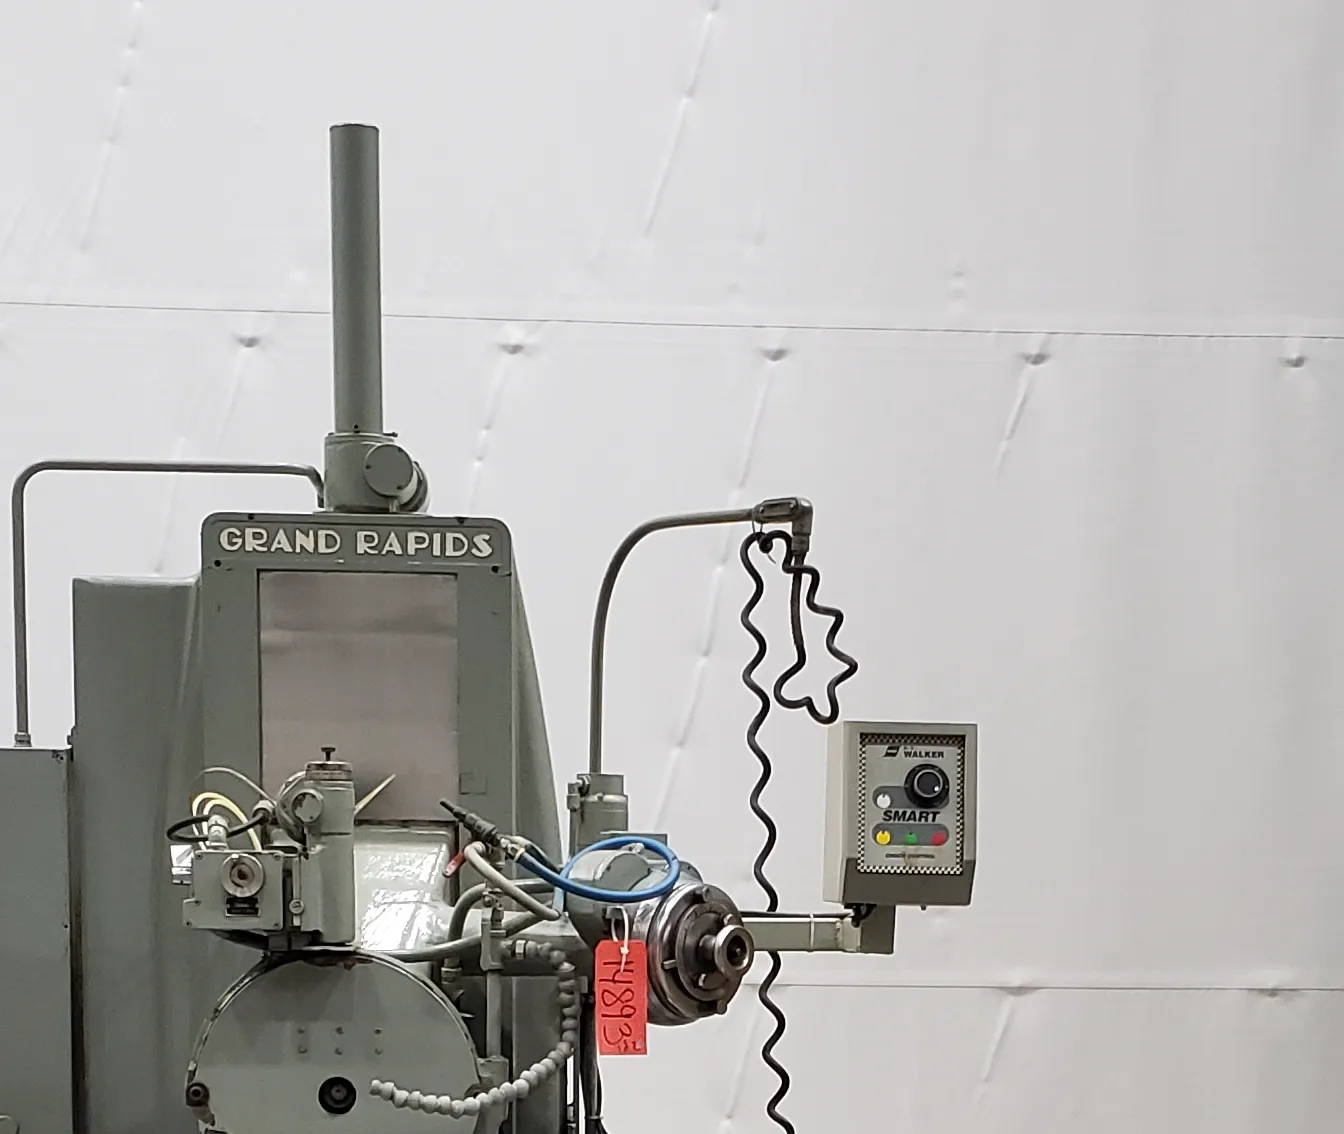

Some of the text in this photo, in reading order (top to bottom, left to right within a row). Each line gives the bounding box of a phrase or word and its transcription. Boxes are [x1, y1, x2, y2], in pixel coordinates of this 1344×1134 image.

[219, 527, 493, 557] GRAND RAPIDS
[904, 750, 945, 759] WALKER
[882, 810, 940, 822] SMART
[599, 961, 637, 1046] 14893
